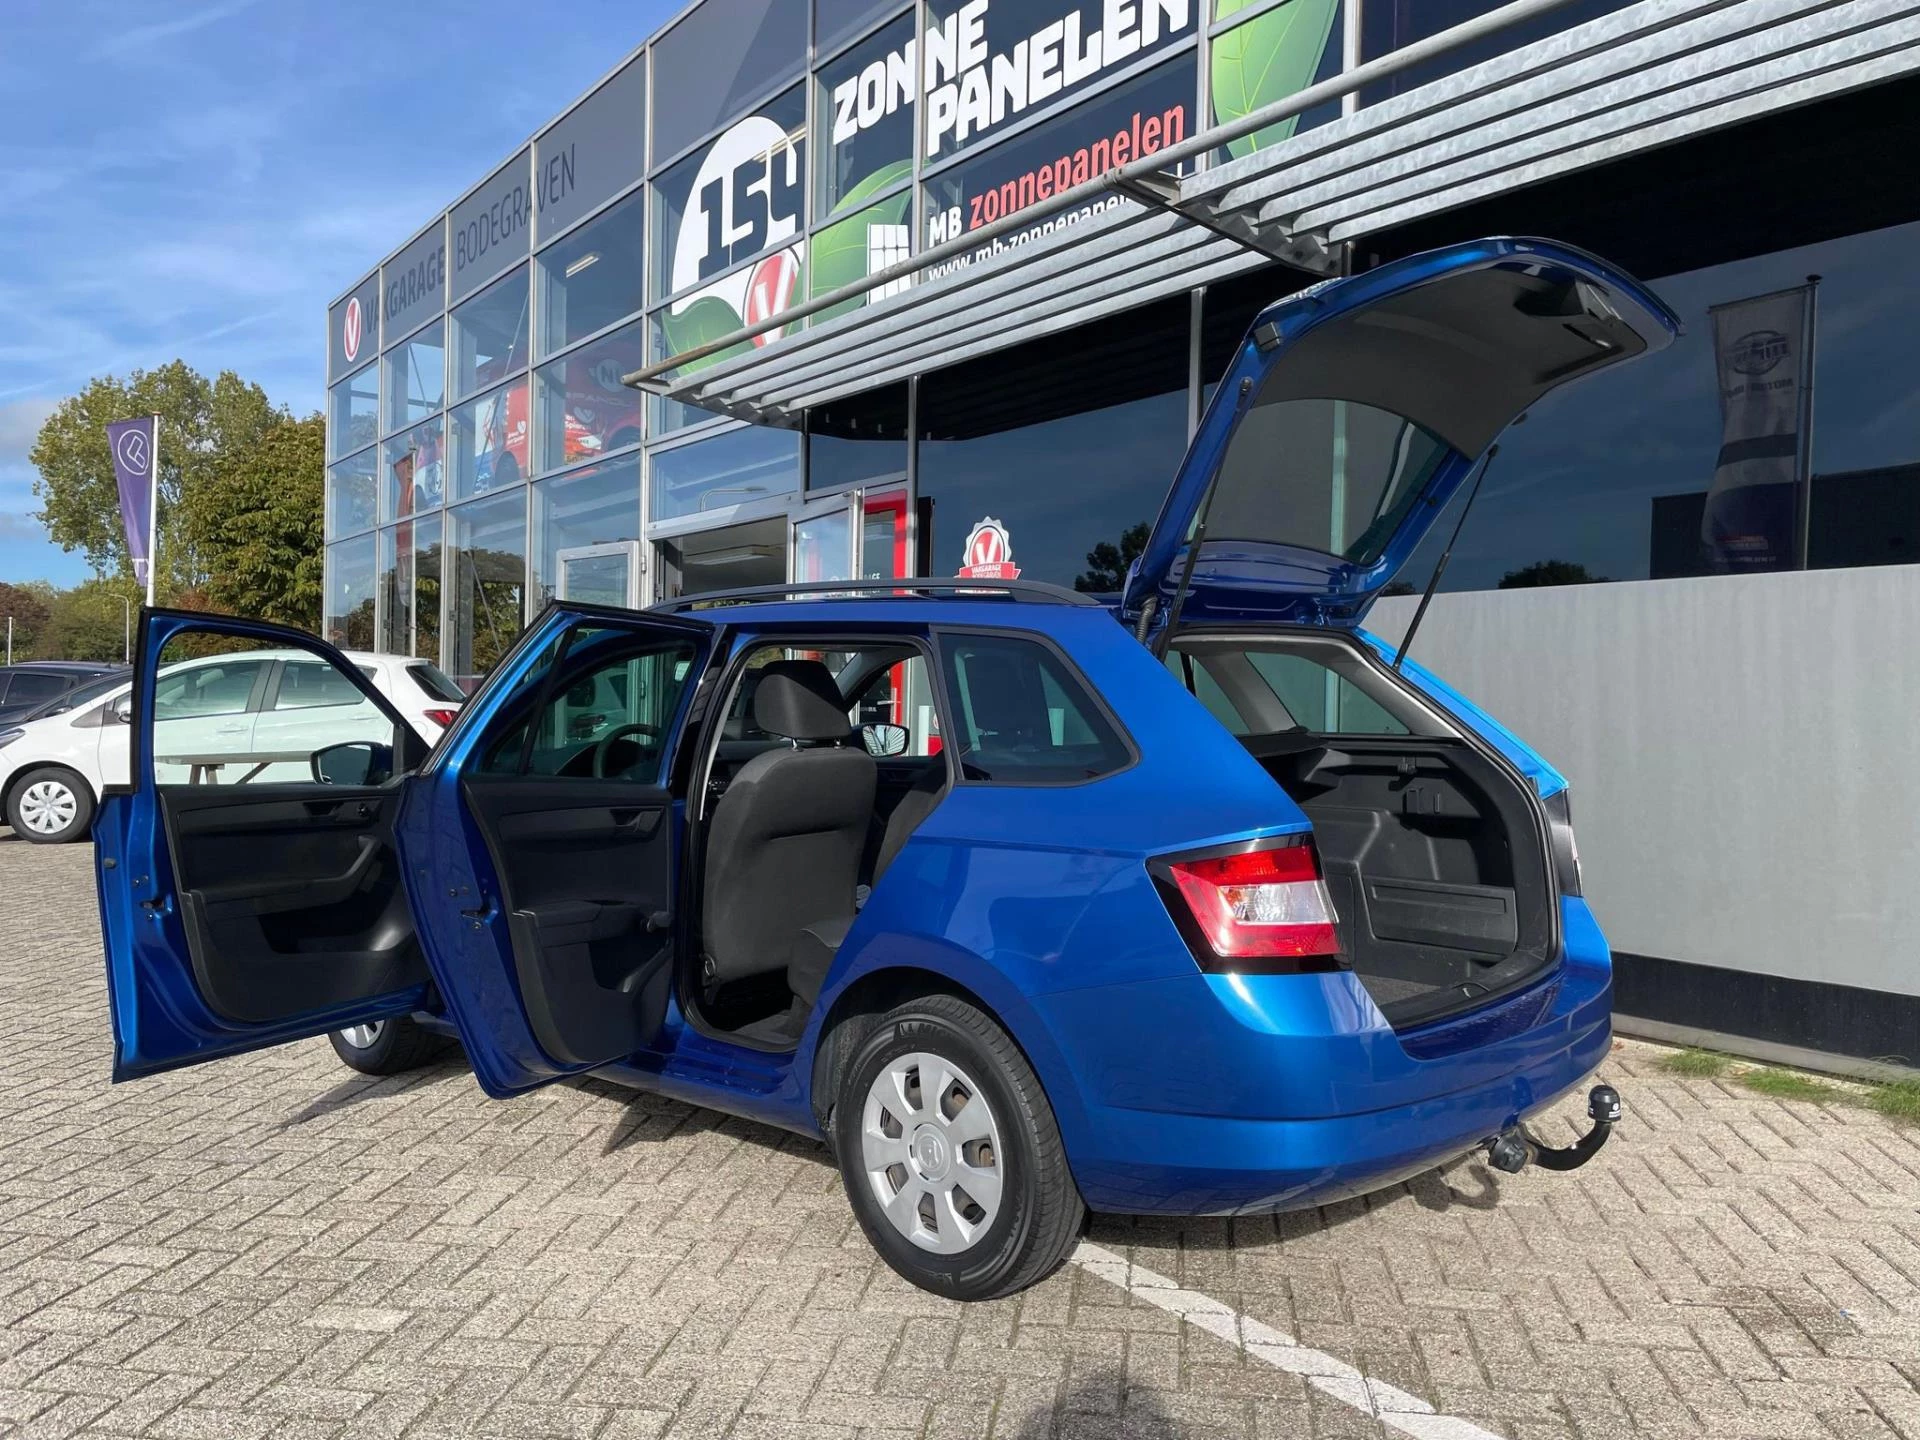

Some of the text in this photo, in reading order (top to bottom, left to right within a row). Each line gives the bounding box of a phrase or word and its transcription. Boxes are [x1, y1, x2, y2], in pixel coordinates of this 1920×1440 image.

[833, 0, 989, 145] ZONNE
[928, 0, 1189, 157] PANELEN
[456, 142, 575, 272] BODEGRAVEN
[929, 104, 1185, 248] MB zonnepanelen
